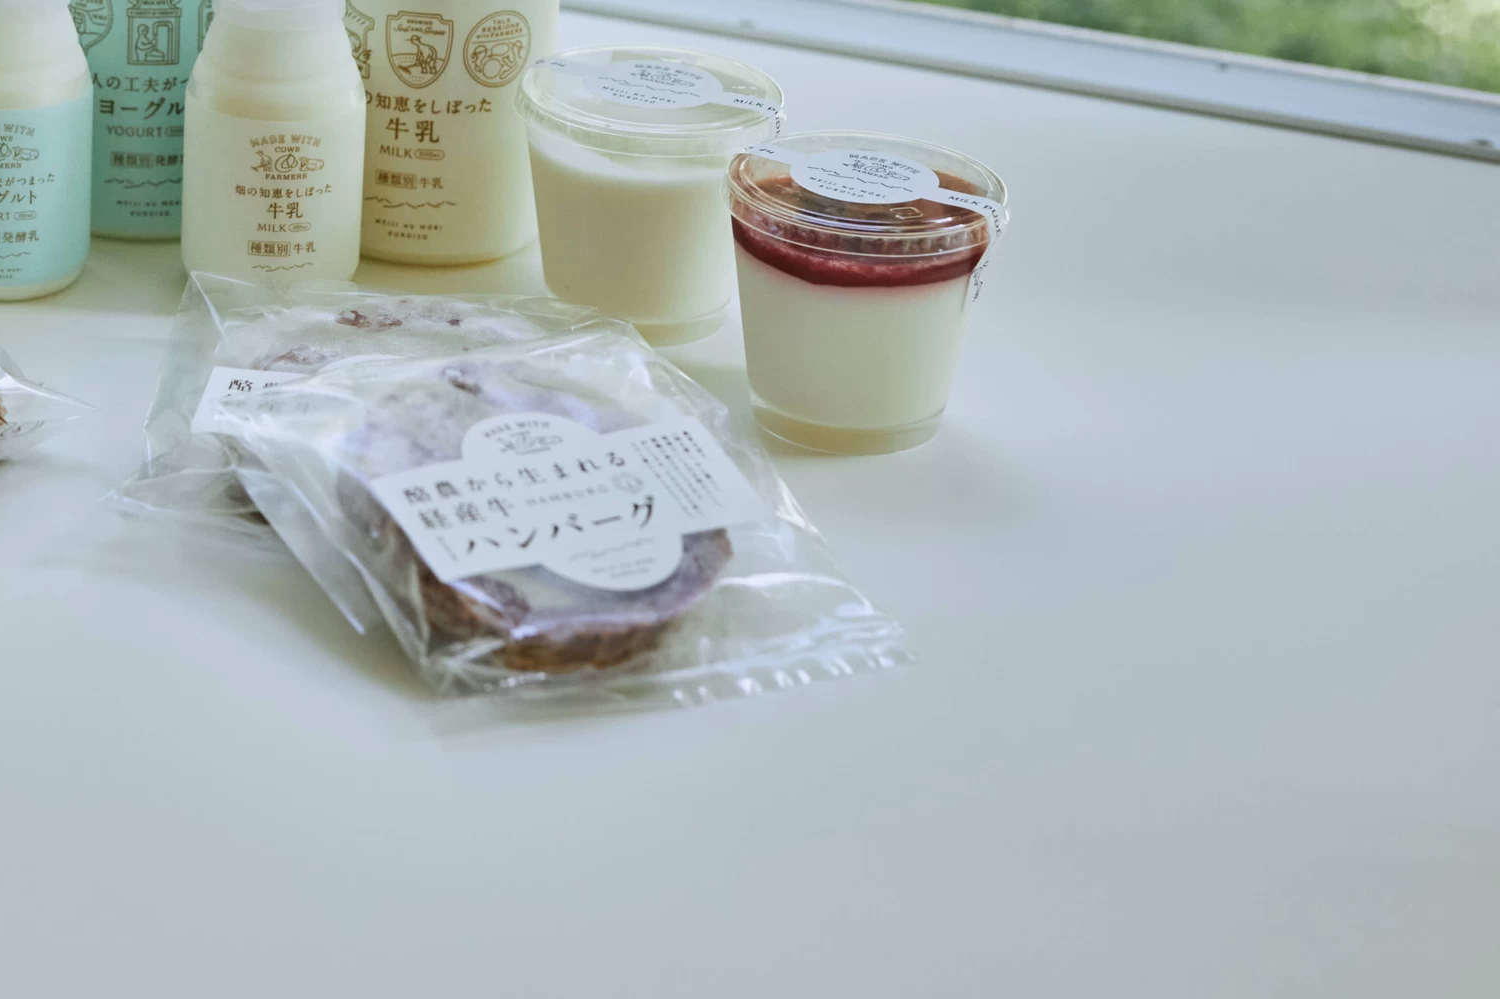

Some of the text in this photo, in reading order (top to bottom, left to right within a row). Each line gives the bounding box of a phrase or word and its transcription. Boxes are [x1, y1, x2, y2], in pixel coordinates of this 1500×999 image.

[733, 98, 764, 108] MILK
[4, 123, 36, 137] WITH
[106, 124, 162, 137] YOGURT
[385, 117, 440, 144] 牛乳
[250, 134, 321, 148] MADE WITH
[379, 144, 413, 159] MILK
[265, 173, 307, 181] FARMERS
[235, 183, 332, 199] 畑の知恵をしぼった
[809, 176, 837, 186] MEIJI
[860, 189, 886, 198] MORI
[819, 184, 864, 198] KUROISO
[948, 196, 981, 206] MILK
[266, 202, 303, 219] 牛乳
[257, 223, 286, 233] MILK
[251, 241, 316, 255] 種類別 牛乳
[403, 451, 625, 504] 酪農から生まれる
[418, 496, 516, 530] 経産牛
[467, 494, 655, 553] ハンバーグ
